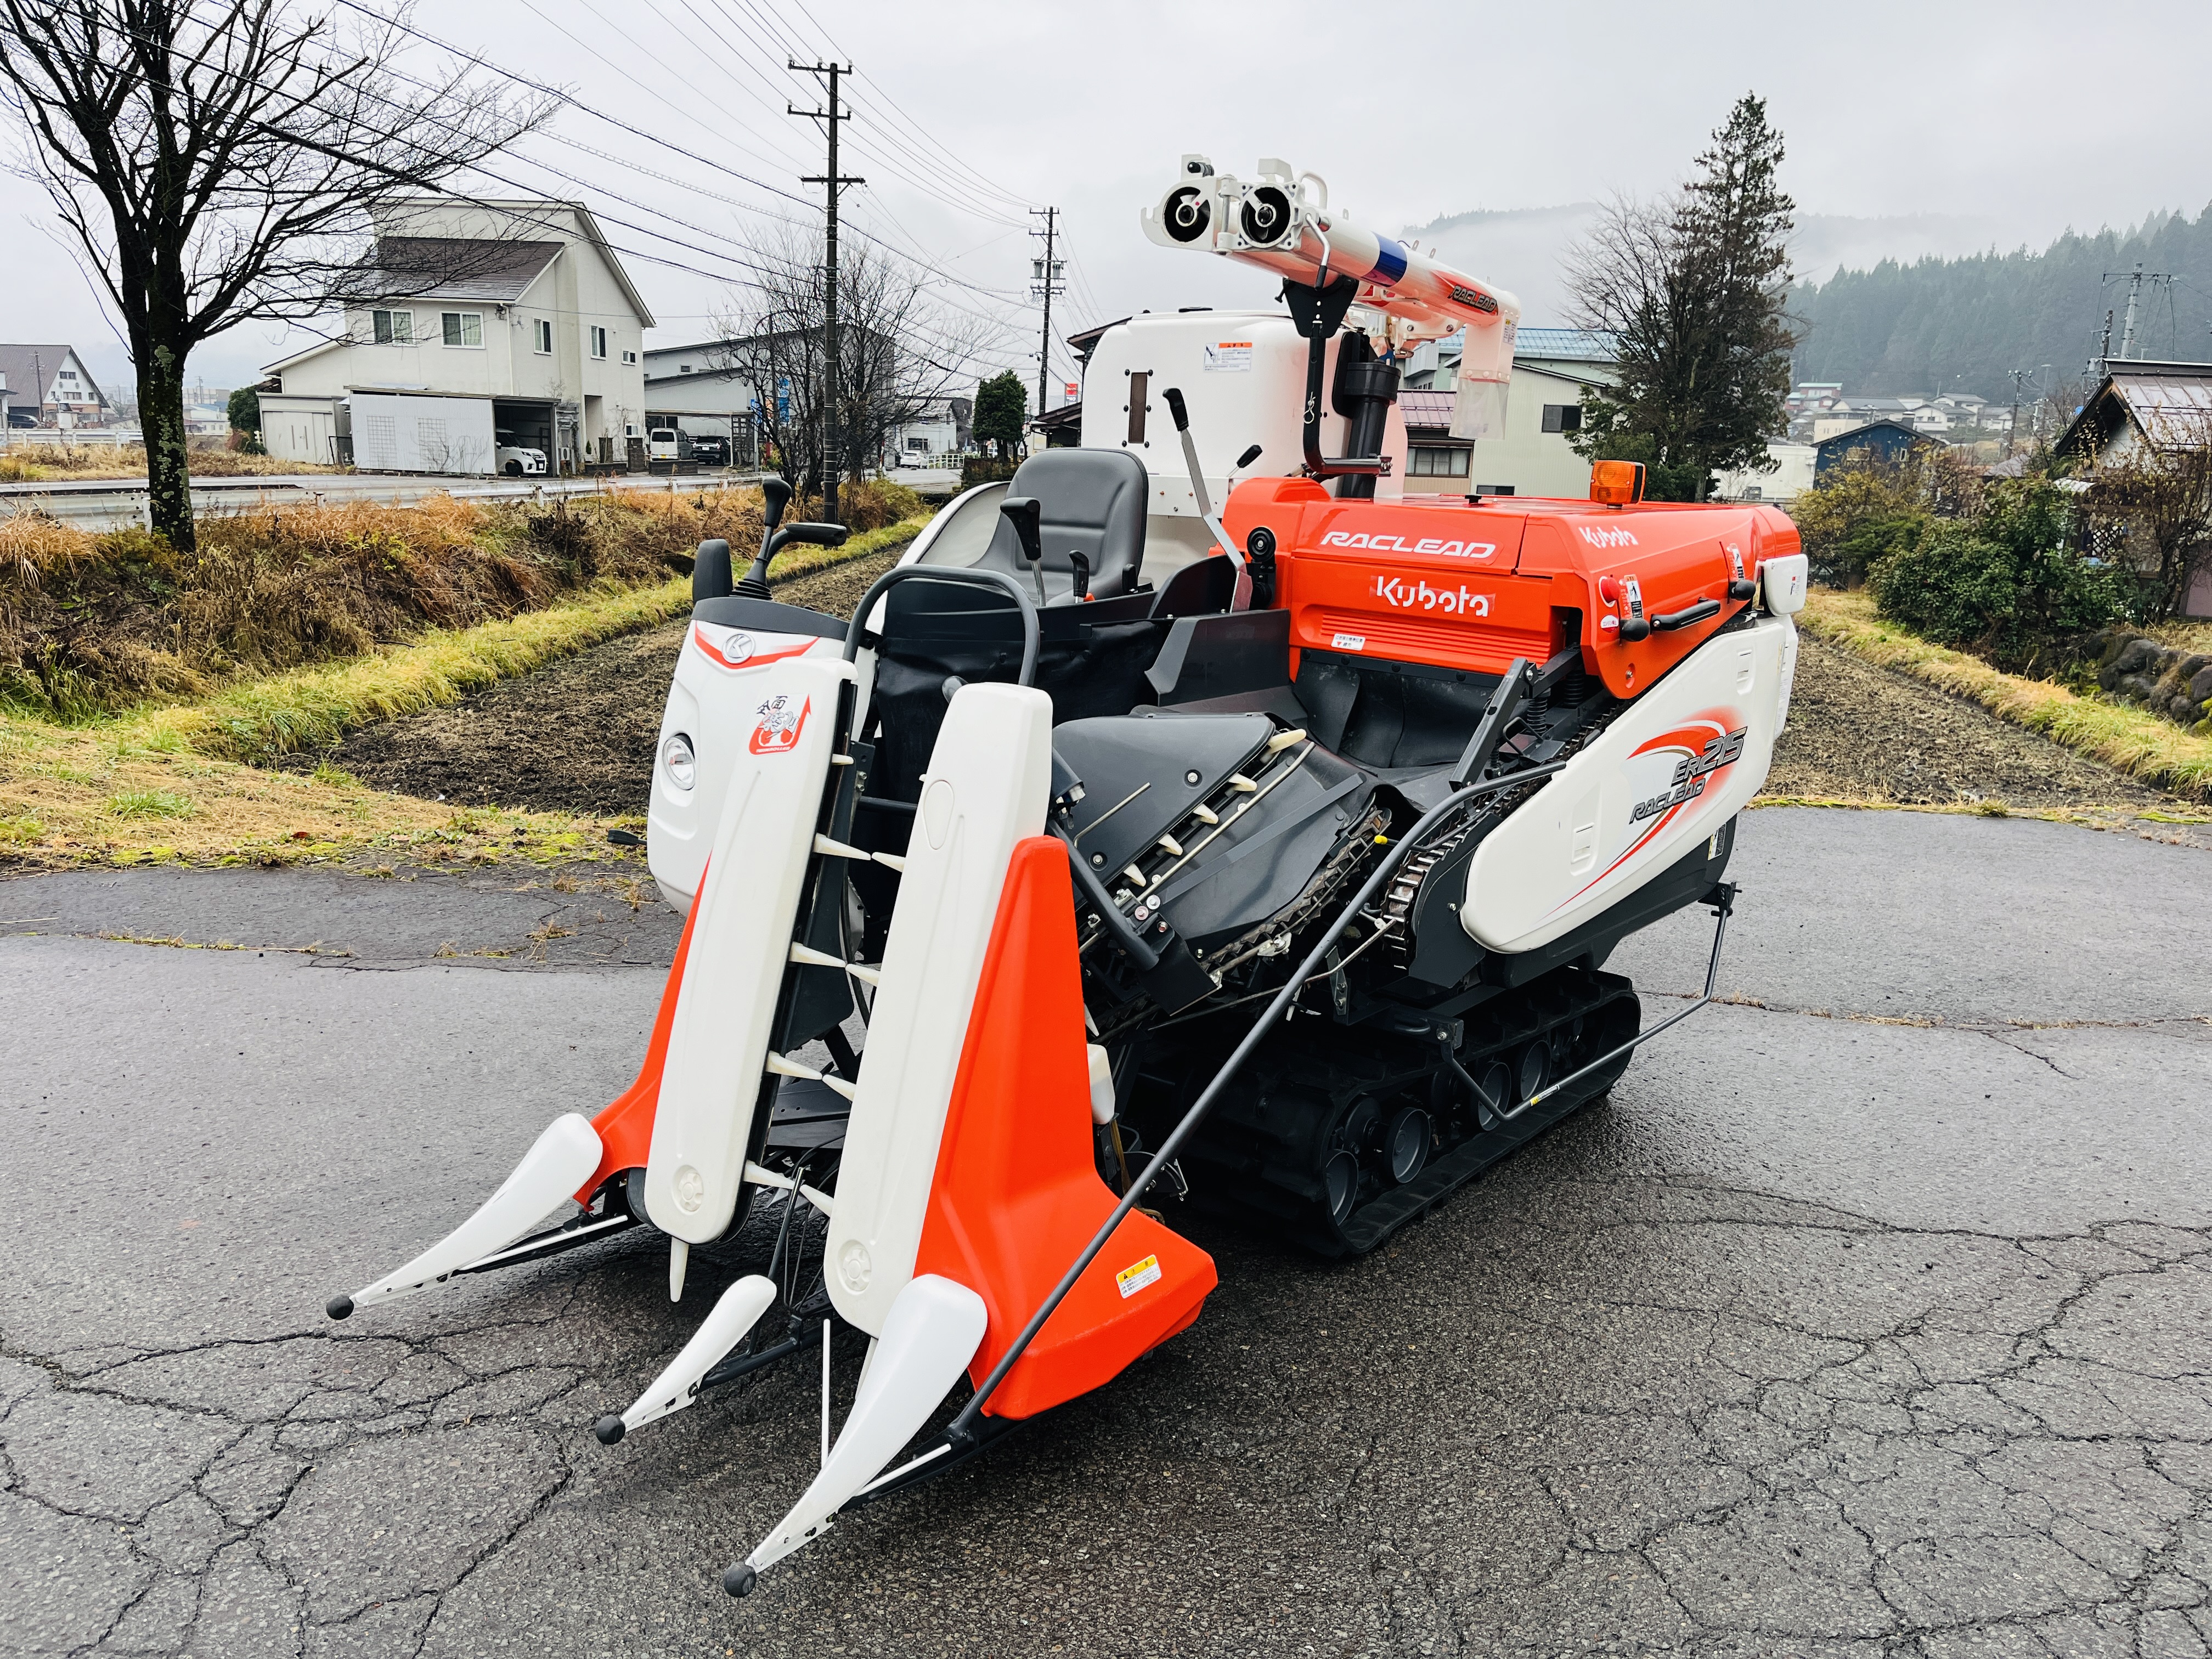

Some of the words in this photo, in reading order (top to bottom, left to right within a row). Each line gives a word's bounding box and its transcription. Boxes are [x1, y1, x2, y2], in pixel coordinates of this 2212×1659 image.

[1447, 284, 1497, 313] RACLEAD
[1320, 531, 1496, 558] RACLEAD
[1578, 526, 1639, 548] Kubota
[1376, 576, 1489, 617] Kubota
[1671, 725, 1748, 787] ER215
[1629, 777, 1706, 825] RACLEAD
